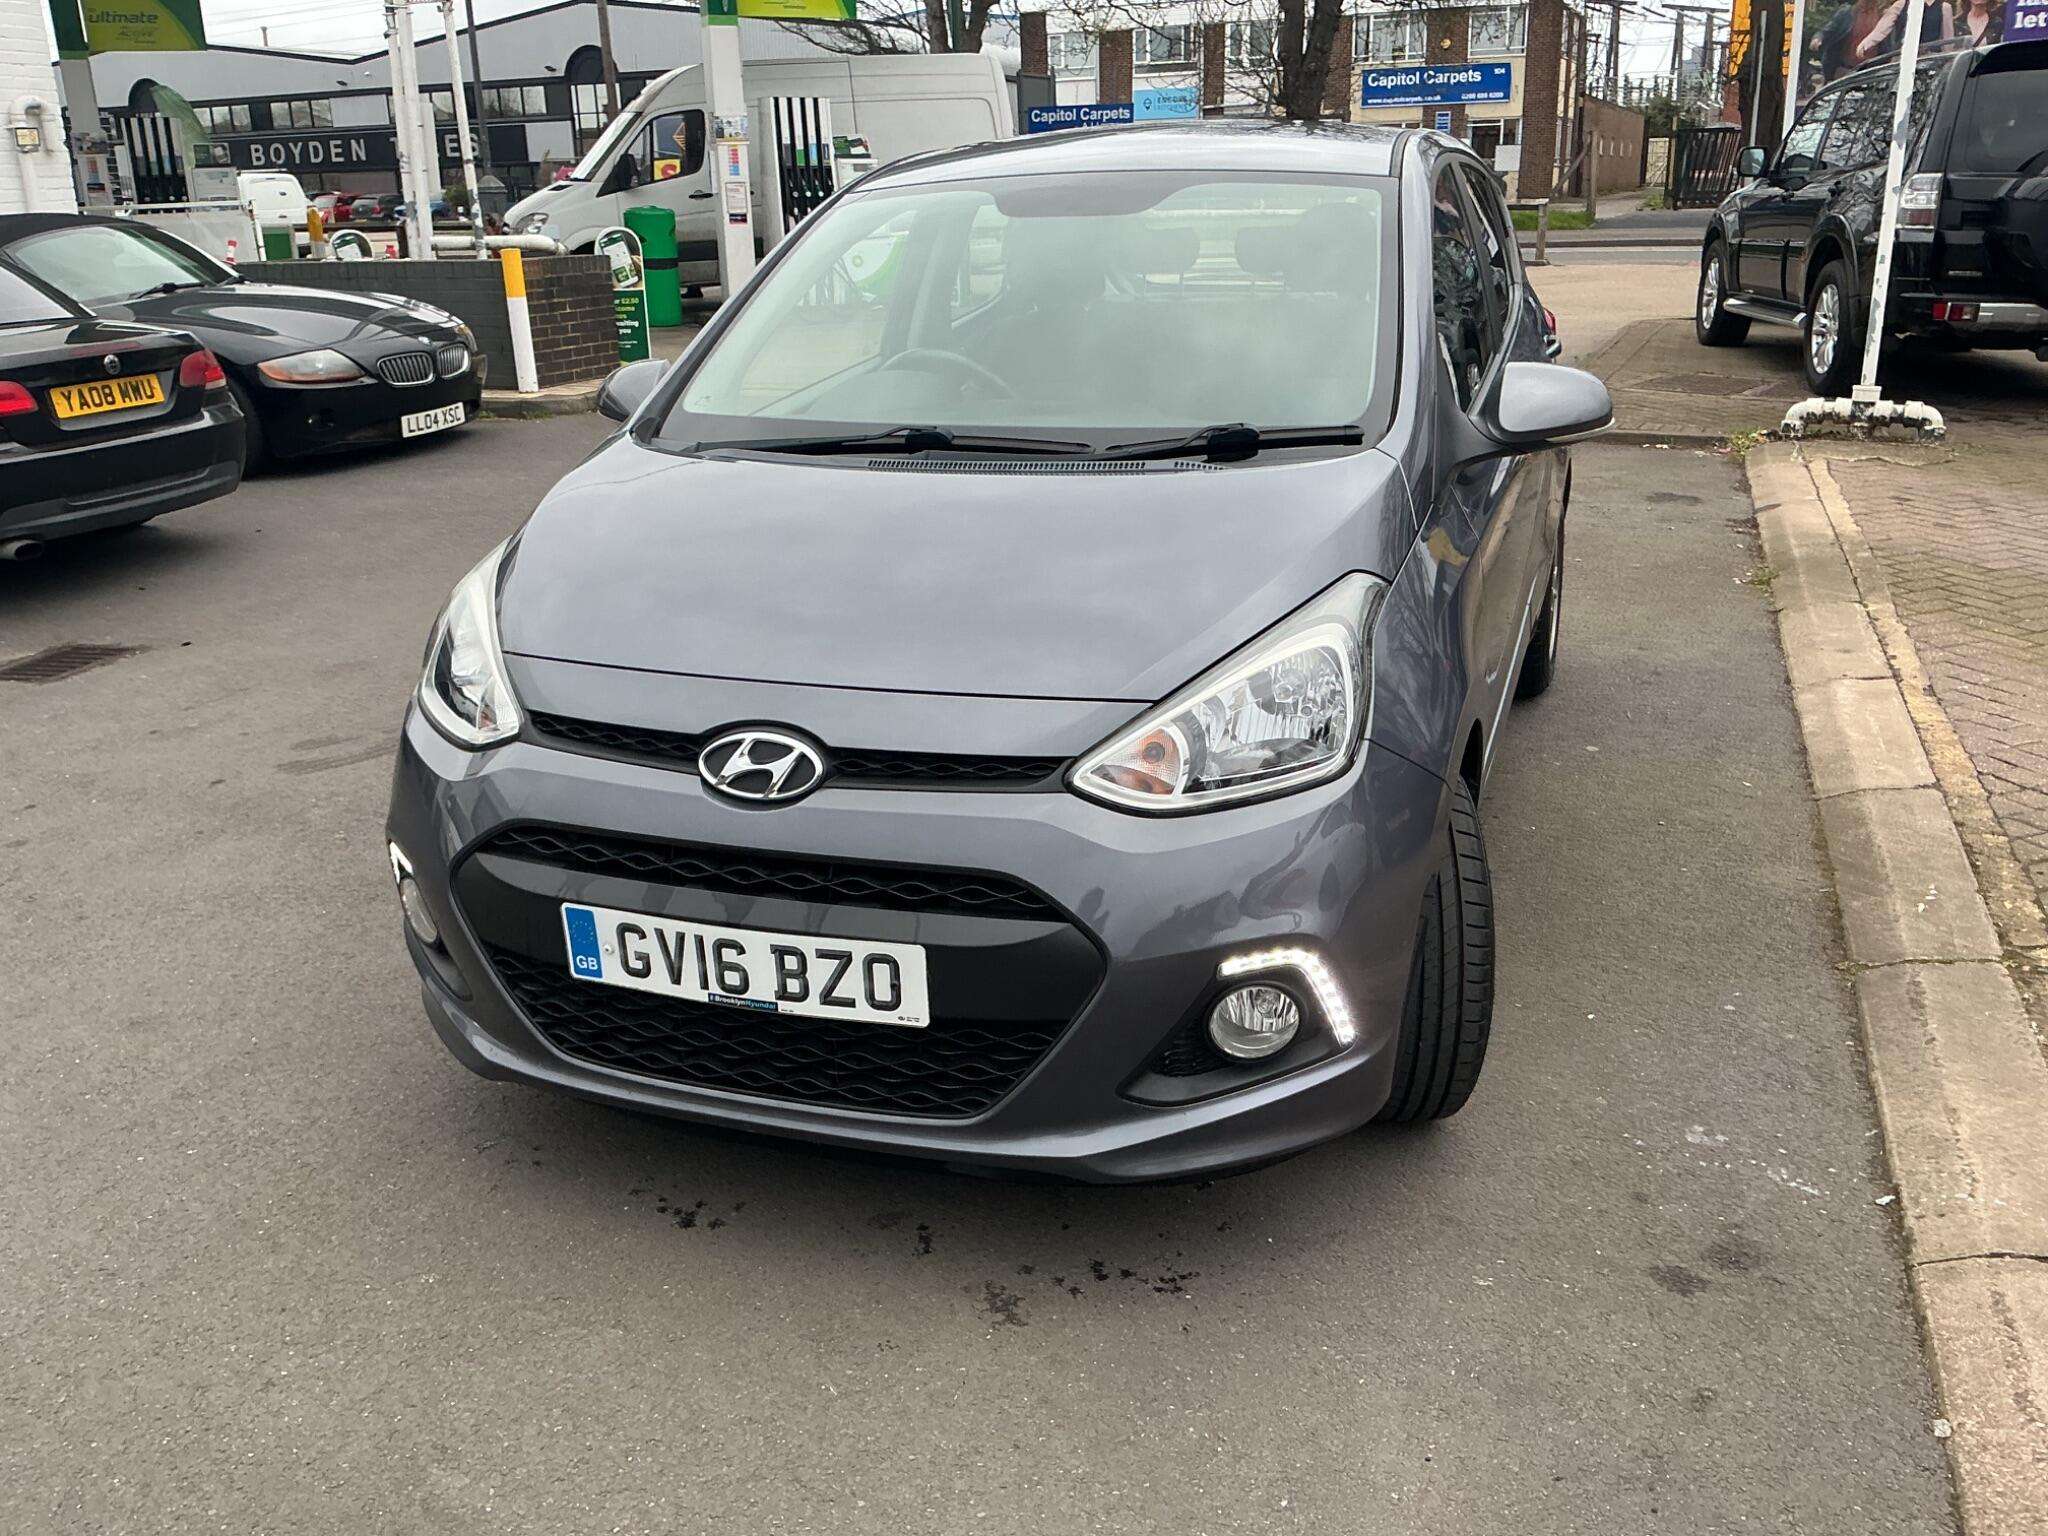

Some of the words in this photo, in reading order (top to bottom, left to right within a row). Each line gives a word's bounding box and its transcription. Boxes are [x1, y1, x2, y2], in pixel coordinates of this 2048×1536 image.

[88, 10, 158, 24] ultimate
[1368, 71, 1420, 89] Capitol
[1423, 69, 1482, 85] Carpets
[1031, 108, 1077, 124] Capitol
[1080, 106, 1130, 122] Carpets
[250, 138, 367, 166] BOYDEN
[60, 384, 116, 412] YA08
[407, 413, 439, 434] LL04
[441, 406, 461, 425] XSC
[576, 955, 598, 971] GB
[616, 922, 750, 995] GV16
[770, 943, 901, 1012] BZO
